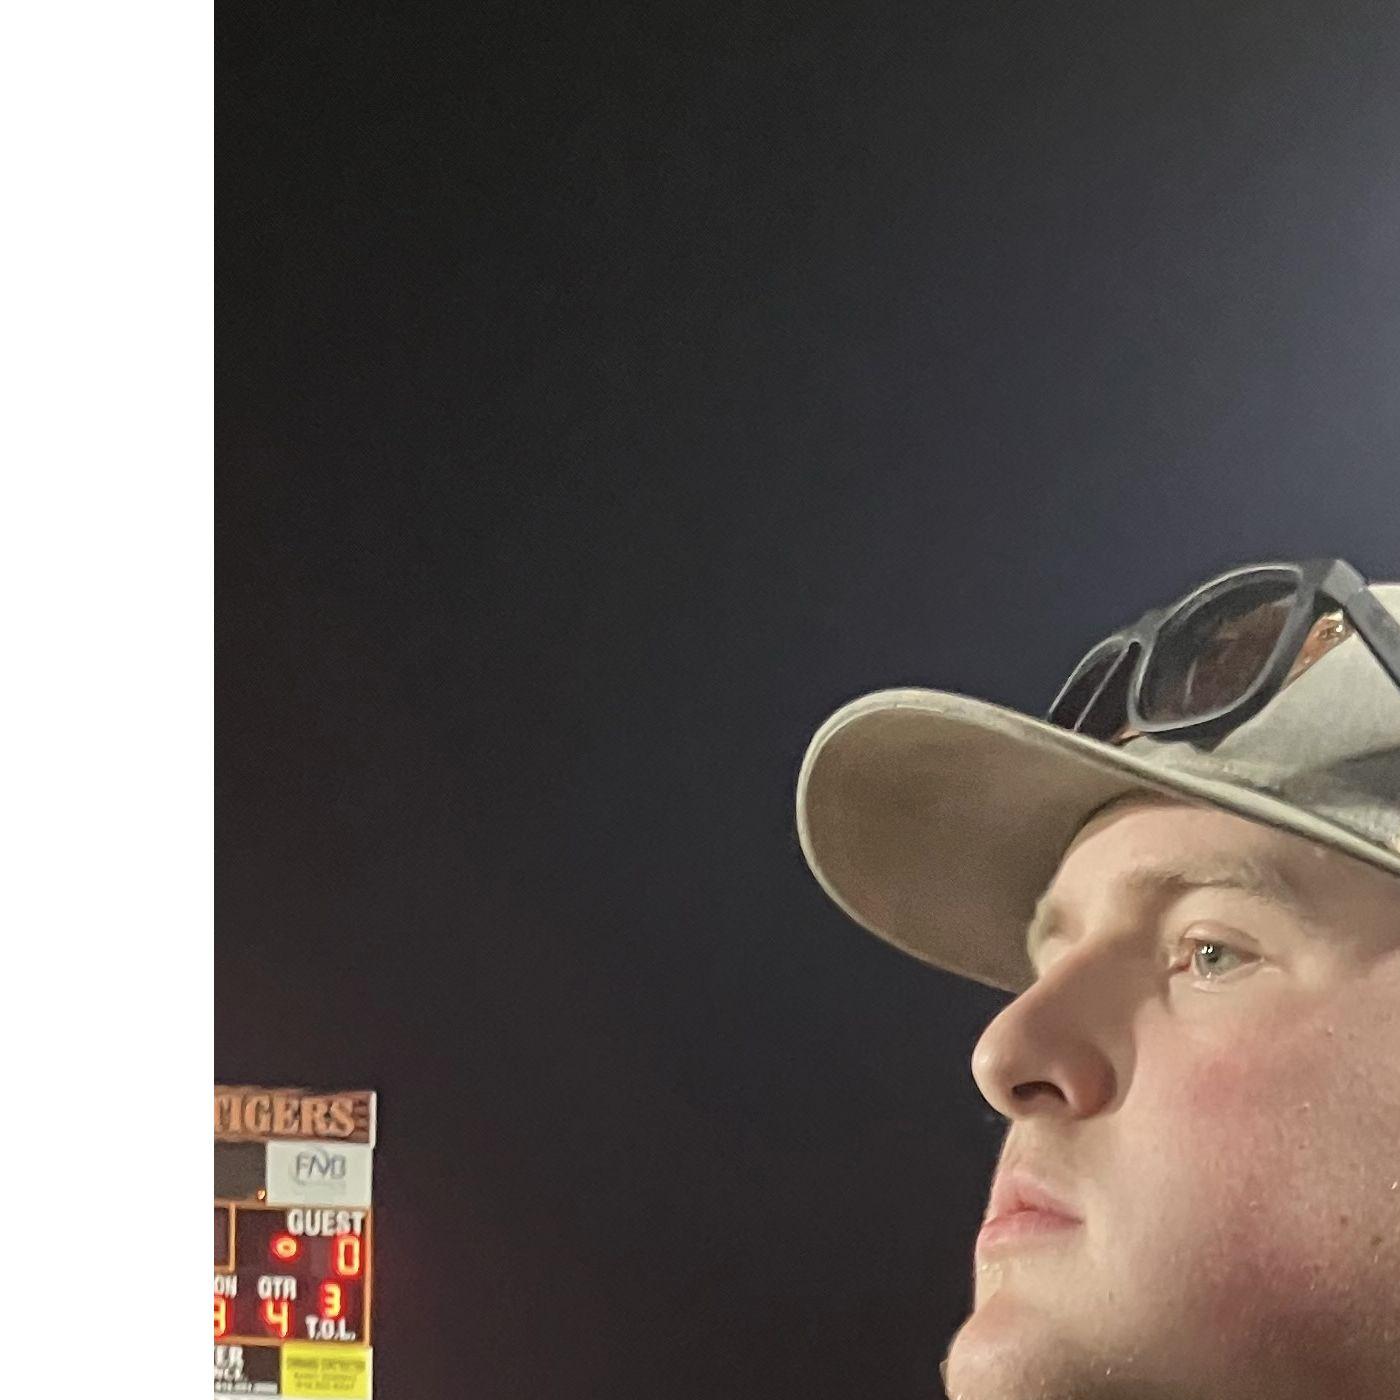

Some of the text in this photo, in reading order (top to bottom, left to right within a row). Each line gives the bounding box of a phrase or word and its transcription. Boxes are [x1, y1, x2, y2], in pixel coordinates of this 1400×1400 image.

[287, 1208, 364, 1236] GUEST
[337, 1235, 360, 1276] 0
[265, 1298, 289, 1337] 4
[322, 1283, 341, 1319] 3
